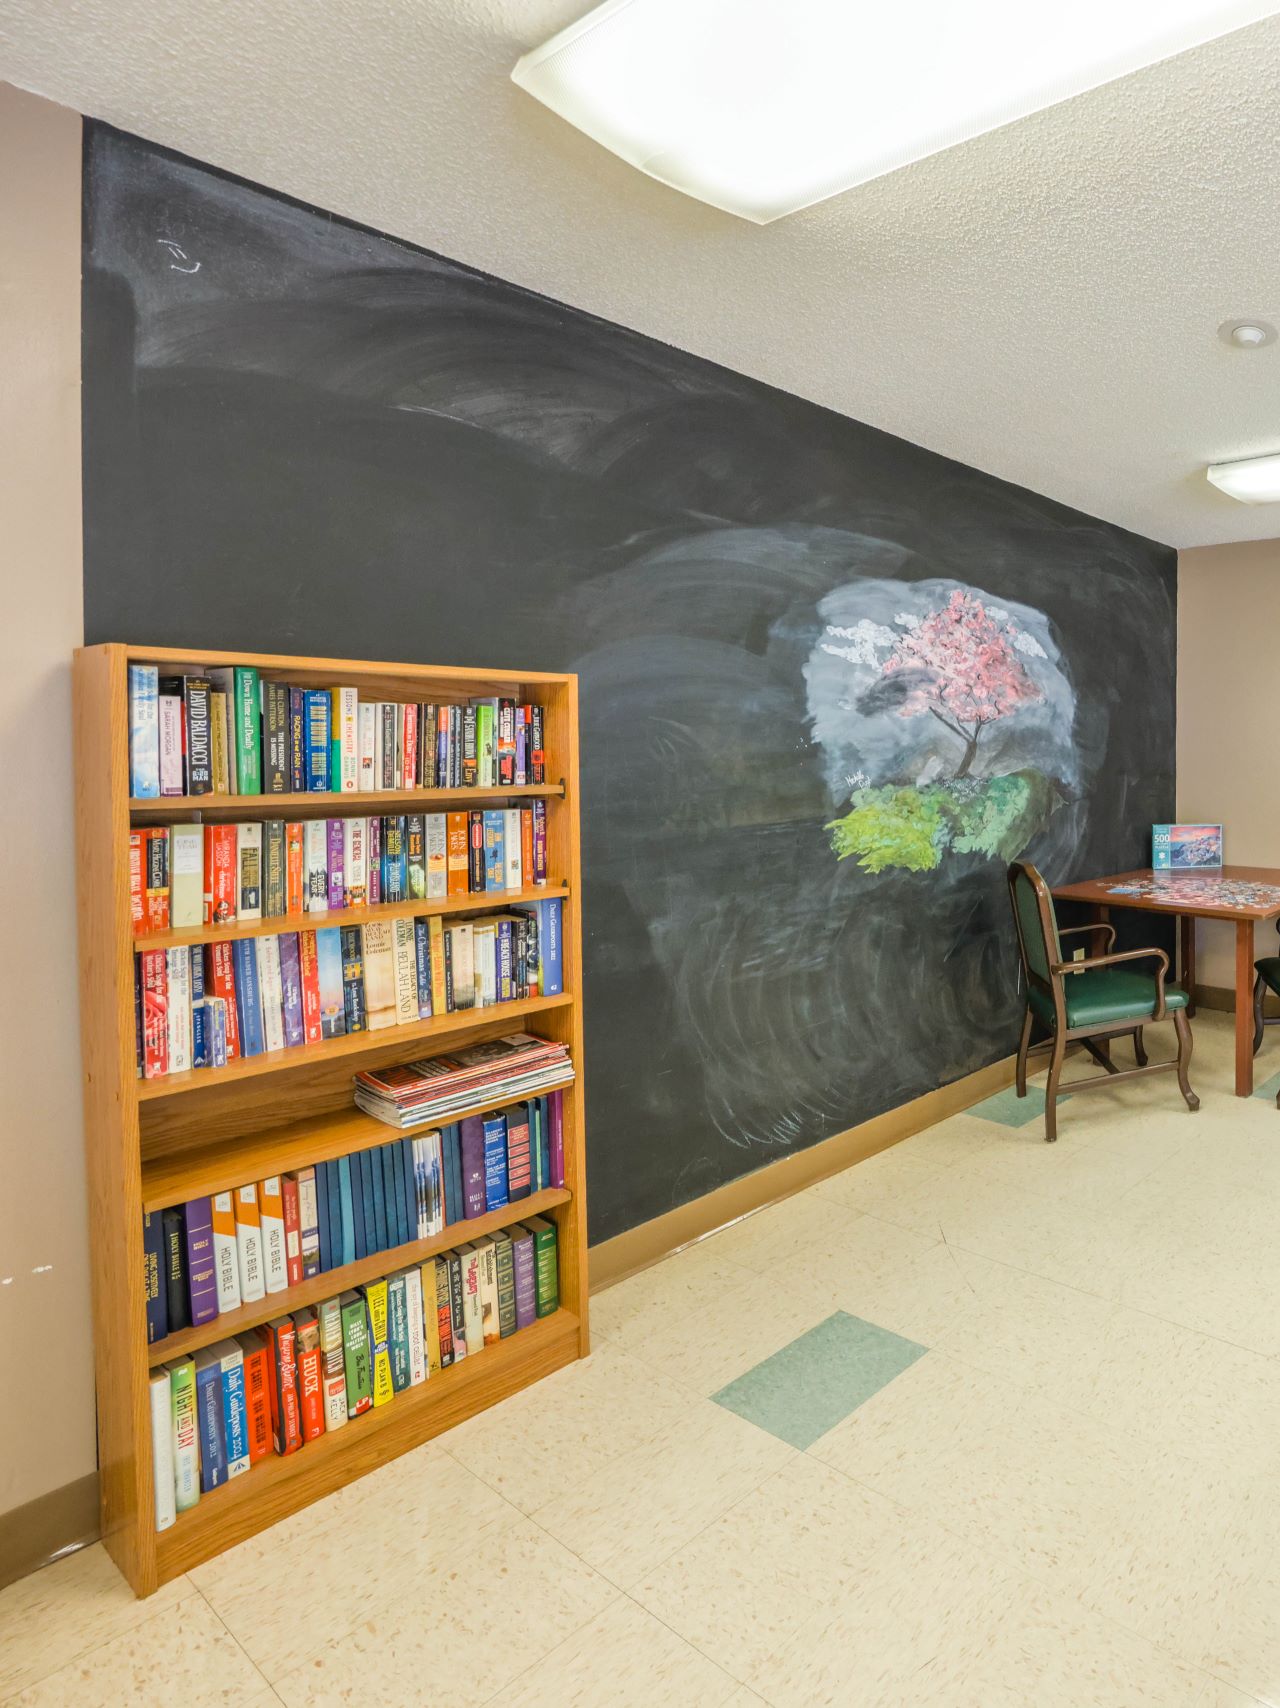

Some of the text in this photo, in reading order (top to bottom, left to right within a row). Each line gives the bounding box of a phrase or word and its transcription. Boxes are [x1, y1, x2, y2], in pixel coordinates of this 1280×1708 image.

[244, 680, 254, 750] Down Home and Deadly
[269, 684, 278, 731] JAMES PATTERSON
[277, 698, 285, 726] CLINTON
[190, 691, 208, 765] DAVID BALDACCI
[310, 705, 327, 747] DAN BROWN
[345, 691, 353, 753] LESSONS CHEMISTRY
[465, 724, 475, 758] SANDRA BROWN
[312, 752, 326, 776] ORIGIN
[463, 768, 476, 783] Envy
[152, 839, 162, 853] MARY
[387, 831, 395, 855] DEMILLE
[394, 831, 402, 854] NELSON
[437, 832, 445, 851] JOHN
[450, 832, 458, 850] JAKES
[1154, 834, 1169, 843] 500
[152, 853, 162, 872] HIGGINS
[223, 840, 231, 868] MIRANDA
[270, 838, 281, 864] DANIELLE
[152, 872, 163, 888] CLARK
[270, 866, 282, 884] STEEL
[310, 877, 318, 894] FEAR
[317, 874, 325, 894] EVERY
[396, 920, 406, 947] COLEMAN
[405, 921, 414, 942] LONNIE
[222, 943, 231, 962] Chicken
[418, 936, 428, 972] Christmas
[501, 943, 510, 960] BEACH
[155, 954, 164, 974] Chicken
[178, 967, 187, 978] Soup
[216, 966, 224, 977] Soul
[223, 962, 231, 974] Soup
[244, 956, 252, 976] BADER
[502, 960, 510, 977] HOUSE
[147, 978, 156, 988] Soul
[153, 974, 163, 986] Soup
[246, 977, 254, 1007] GINSBURG
[398, 951, 411, 1013] BEULAH LAND
[156, 995, 164, 1003] the
[352, 999, 360, 1022] Bookshop
[170, 1236, 181, 1271] HOLY BIBLE
[245, 1237, 258, 1282] HOLY BIBLE
[270, 1229, 281, 1273] HOLY BIBLE
[221, 1247, 234, 1292] HOLY BIBLE
[467, 1266, 479, 1295] Legacy
[150, 1271, 159, 1298] POSITIVELY
[373, 1296, 387, 1341] LEE CHILD
[351, 1342, 364, 1351] WALK
[327, 1347, 345, 1374] DITCH
[378, 1359, 386, 1368] NO
[251, 1356, 263, 1393] THE CARTEL
[303, 1354, 319, 1397] HUCK
[356, 1366, 366, 1390] Fountain
[379, 1369, 387, 1382] PLAN
[206, 1381, 215, 1402] DAILY
[176, 1384, 194, 1450] NIGHT AND DAY
[206, 1401, 217, 1440] GUIDEPOSTS
[226, 1368, 242, 1460] Daily Guideposts 2004
[254, 1400, 267, 1444] DON WINSLOW
[330, 1399, 338, 1421] KELLY
